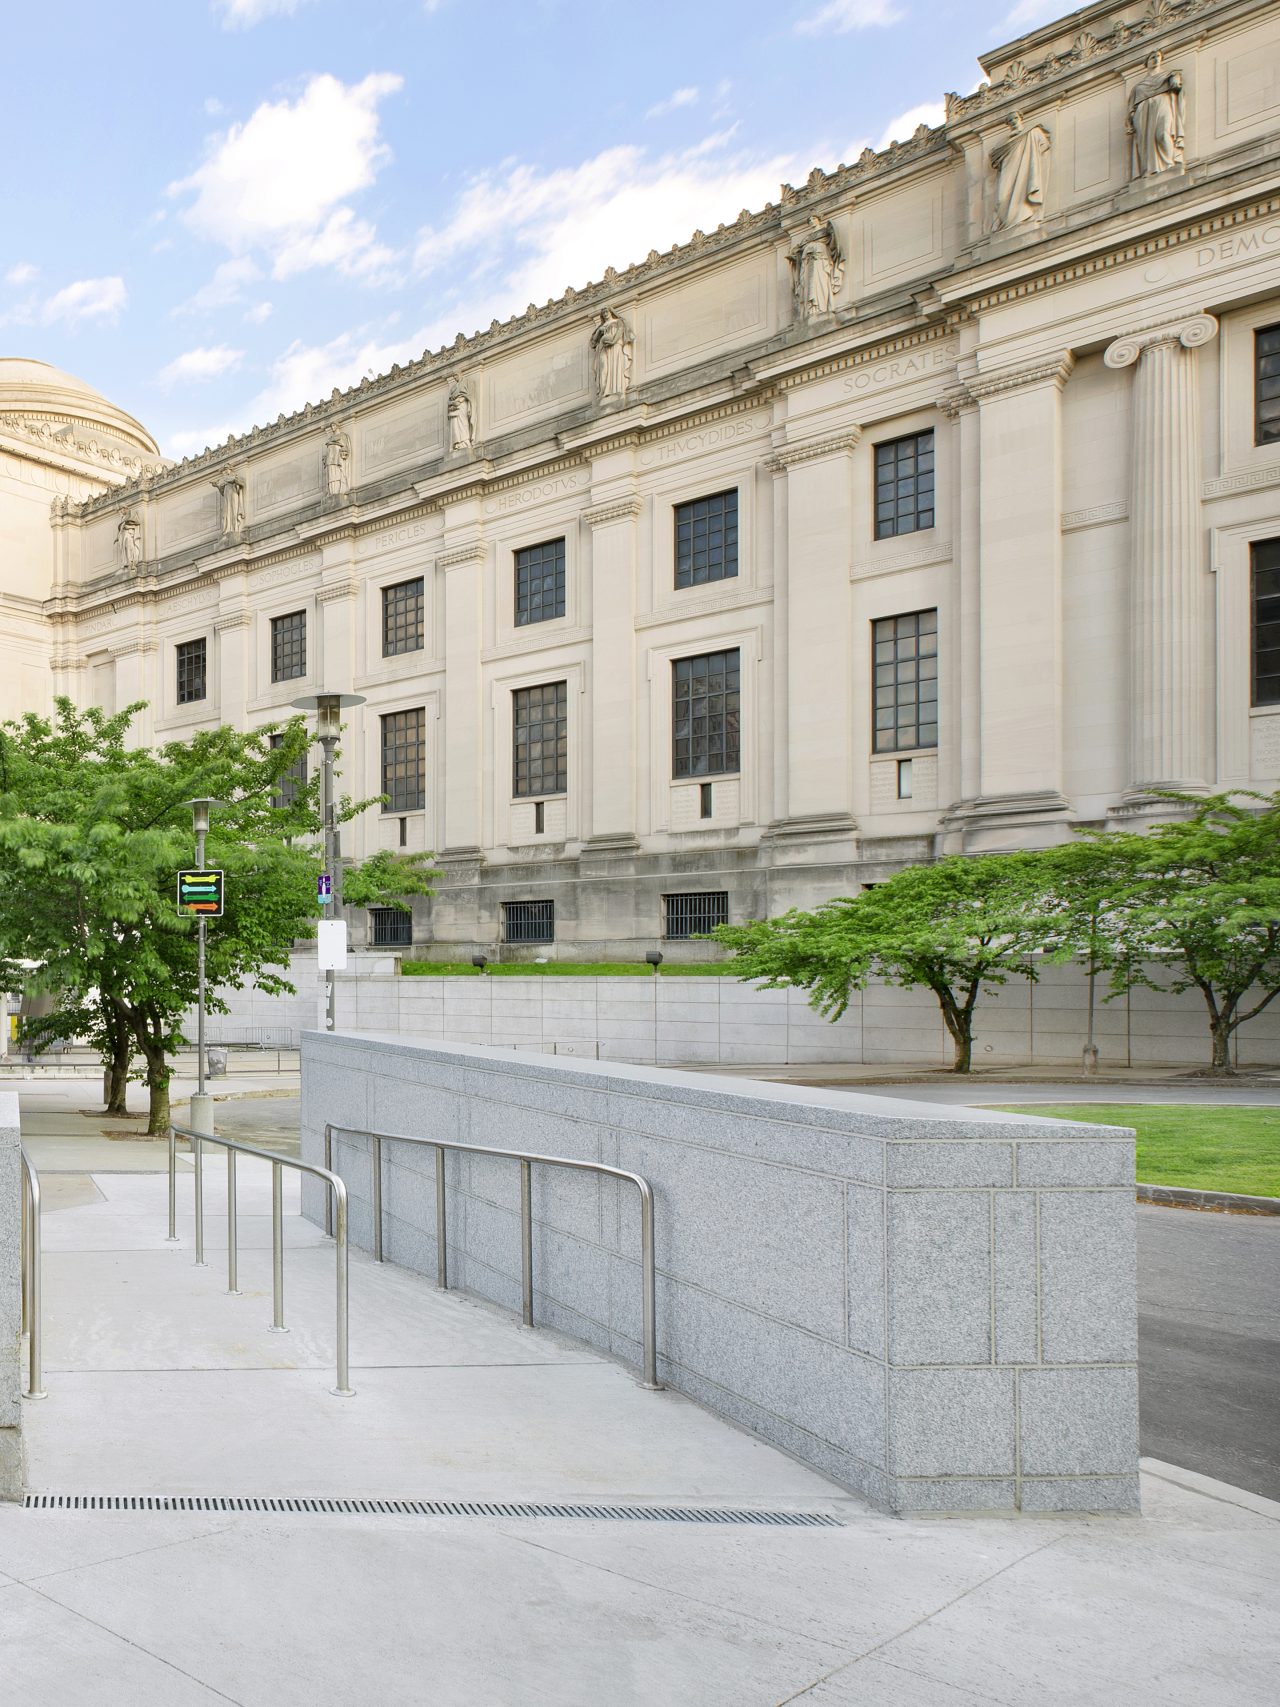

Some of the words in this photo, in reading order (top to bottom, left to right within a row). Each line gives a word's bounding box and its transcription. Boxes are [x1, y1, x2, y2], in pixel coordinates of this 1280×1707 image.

[842, 344, 956, 394] SOCRATES
[658, 419, 753, 460] THVCYDIDES
[499, 475, 577, 510] HERODOTVS
[375, 523, 426, 550] PERICLES
